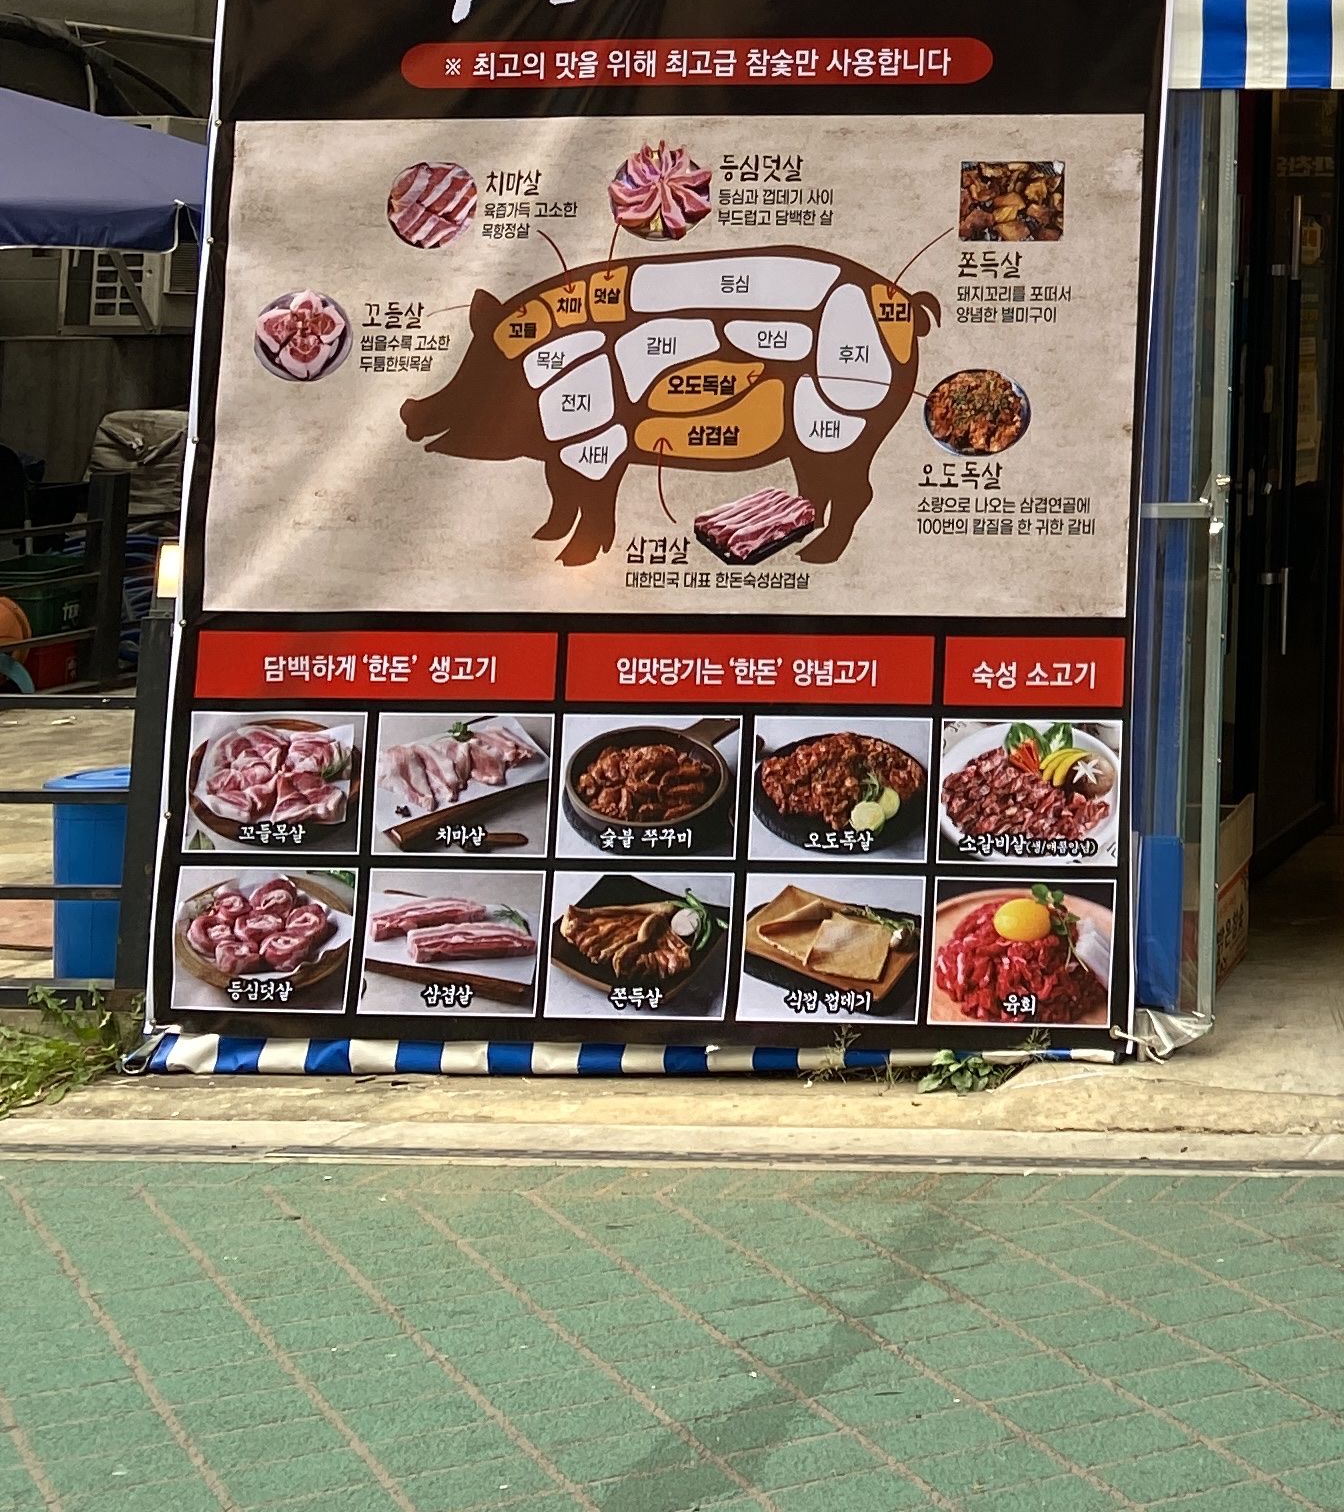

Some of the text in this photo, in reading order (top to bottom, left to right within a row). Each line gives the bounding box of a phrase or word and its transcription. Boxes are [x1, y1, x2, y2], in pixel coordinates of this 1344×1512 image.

[472, 46, 952, 80] 최고의 맛을 위해 최고급 참숯만 사용합니다
[718, 154, 804, 183] 등심덧살
[484, 169, 542, 196] 치마살
[718, 188, 834, 206] 등심과 껍데기 사이
[484, 201, 577, 219] 육즙가득 고소한
[717, 209, 834, 227] 부드럽고 담백한 살
[481, 222, 530, 240] 목항정살
[957, 250, 1022, 279] 쫀득살
[720, 275, 750, 294] 등심
[956, 286, 1072, 303] 돼지꼬리를 포떠서
[362, 301, 425, 329] 꼬들살
[556, 296, 582, 314] 치마
[878, 302, 912, 323] 꼬리
[956, 306, 1058, 323] 양념한 별미구이
[359, 334, 450, 351] 씹을수록 고소한
[646, 336, 677, 356] 갈비
[757, 330, 788, 348] 안심
[536, 351, 565, 370] 목살
[838, 343, 870, 365] 후지
[667, 375, 736, 396] 오도독살
[561, 393, 592, 413] 전지
[687, 425, 740, 446] 삼겹살
[809, 421, 842, 440] 사태
[578, 445, 609, 465] 사태
[918, 462, 1004, 490] 오도독살
[917, 496, 1090, 514] 소량으로 나오는 삼겹연골에
[917, 518, 1096, 536] 100번의 칼질을 한 귀한 갈비
[626, 536, 691, 565] 삼겹살
[625, 571, 810, 589] 대한민국 대표 한돈숙성삼겹살
[263, 652, 356, 685] 담백하게
[429, 653, 498, 686] 생고기
[616, 654, 725, 688] 입맛당기는
[792, 656, 878, 688] 양념고기
[972, 659, 1097, 690] 숙성 소고기
[239, 824, 307, 844] 꼬들목살
[436, 826, 486, 846] 치마살
[599, 828, 634, 849] 숯불
[804, 830, 874, 851] 오도독살
[227, 982, 293, 1003] 등심덧살
[422, 986, 473, 1006] 삼겹살
[609, 987, 663, 1008] 쫀득살
[824, 990, 871, 1012] 껍데기
[1003, 995, 1037, 1015] 육회
